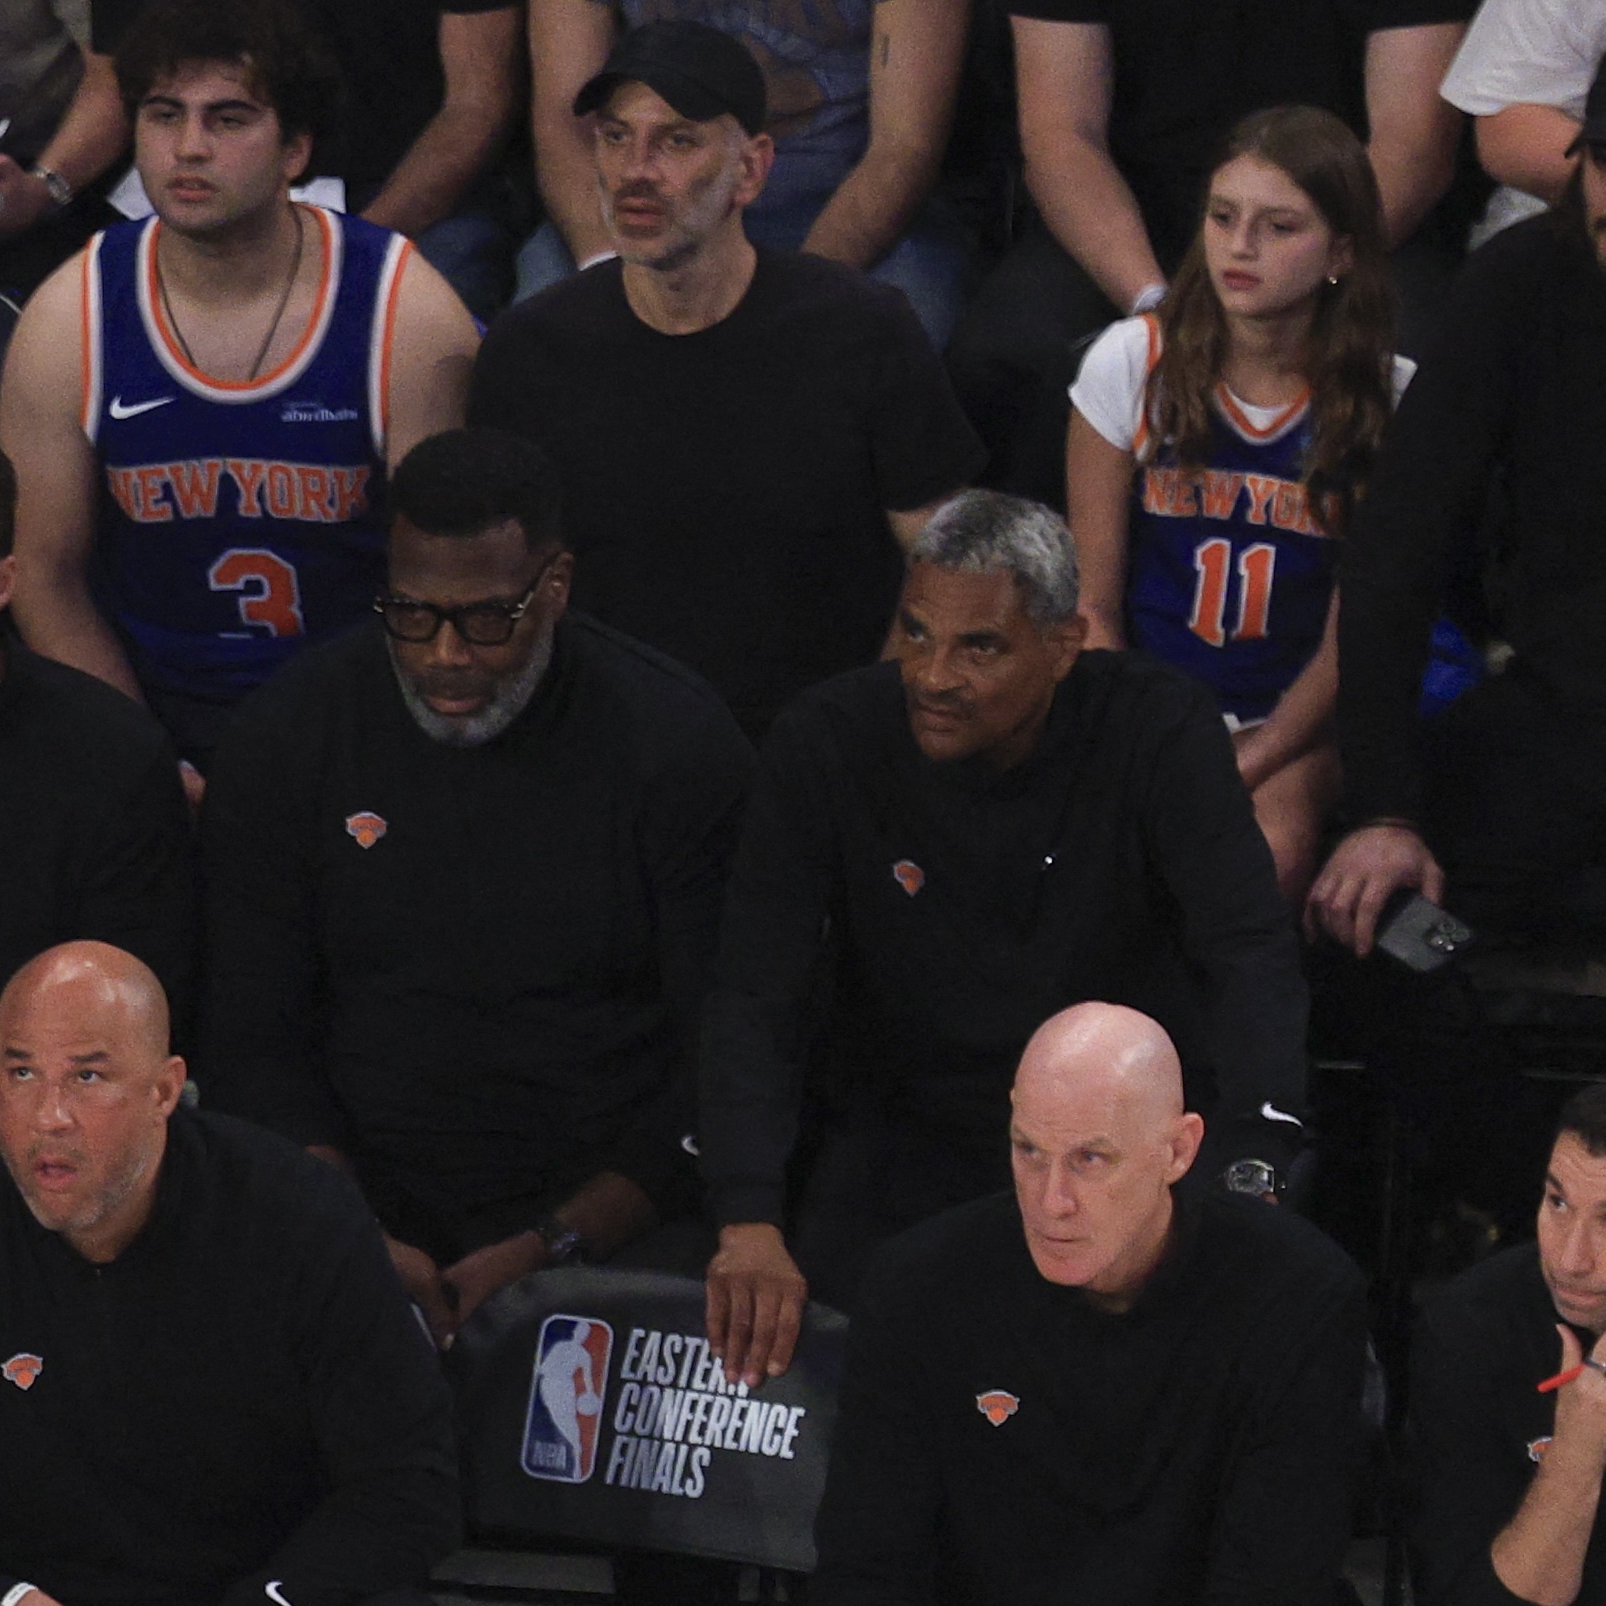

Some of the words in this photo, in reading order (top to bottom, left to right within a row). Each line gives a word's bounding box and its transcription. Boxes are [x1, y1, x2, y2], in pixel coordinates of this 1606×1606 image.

[106, 458, 222, 523] NEW
[223, 457, 370, 524] YORK
[1142, 470, 1241, 521] NEW
[209, 549, 302, 639] 3
[1187, 537, 1276, 648] 11
[614, 1383, 805, 1459] CONFERENCE
[606, 1435, 711, 1499] FINALS
